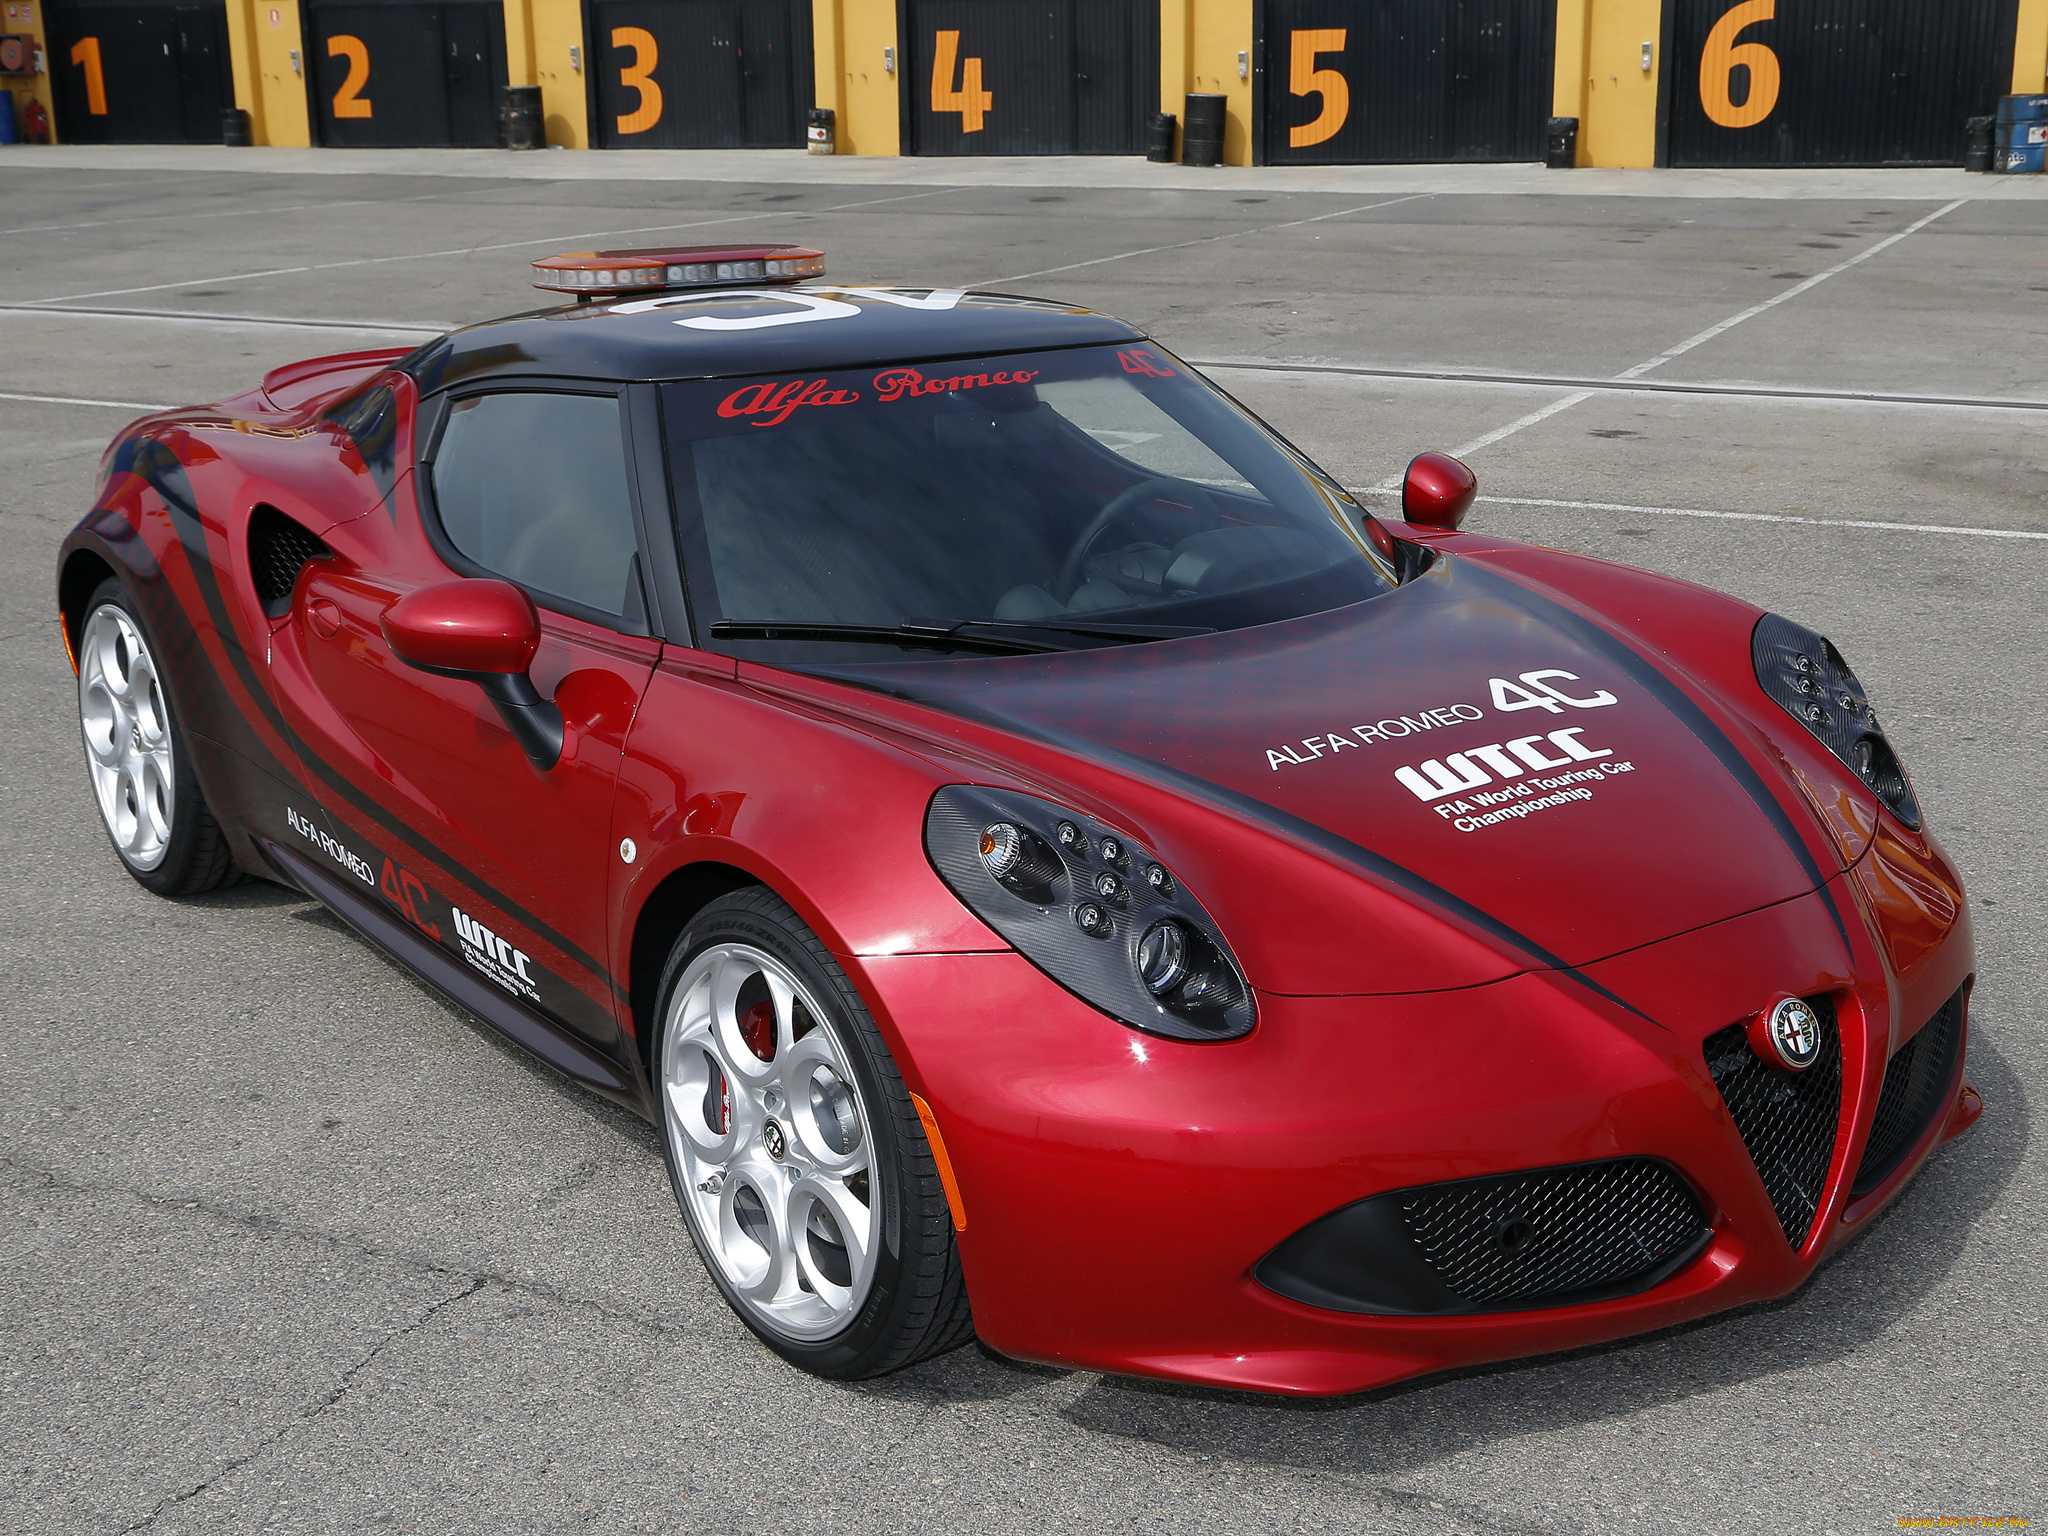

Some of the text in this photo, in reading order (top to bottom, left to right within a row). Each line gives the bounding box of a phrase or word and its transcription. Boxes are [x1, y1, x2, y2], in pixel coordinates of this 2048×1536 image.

[71, 37, 107, 115] 1
[327, 34, 372, 119] 2
[611, 27, 663, 134] 3
[930, 30, 993, 134] 4
[1289, 28, 1350, 148] 5
[1699, 0, 1781, 128] 6
[717, 368, 1040, 427] Alfa Romeo
[1117, 350, 1176, 378] 4C
[1265, 669, 1619, 772] ALFA ROMEO 4C
[1394, 726, 1614, 802] WTCC
[1433, 760, 1636, 819] FIA World Touring Car
[1453, 787, 1593, 833] Championship
[287, 807, 441, 942] ALFA ROMEO 4C
[452, 907, 536, 987] WTCC
[459, 939, 541, 1003] FIA World Touring Car
[464, 952, 519, 997] Championship
[1778, 1003, 1816, 1039] ALFA ROMEO
